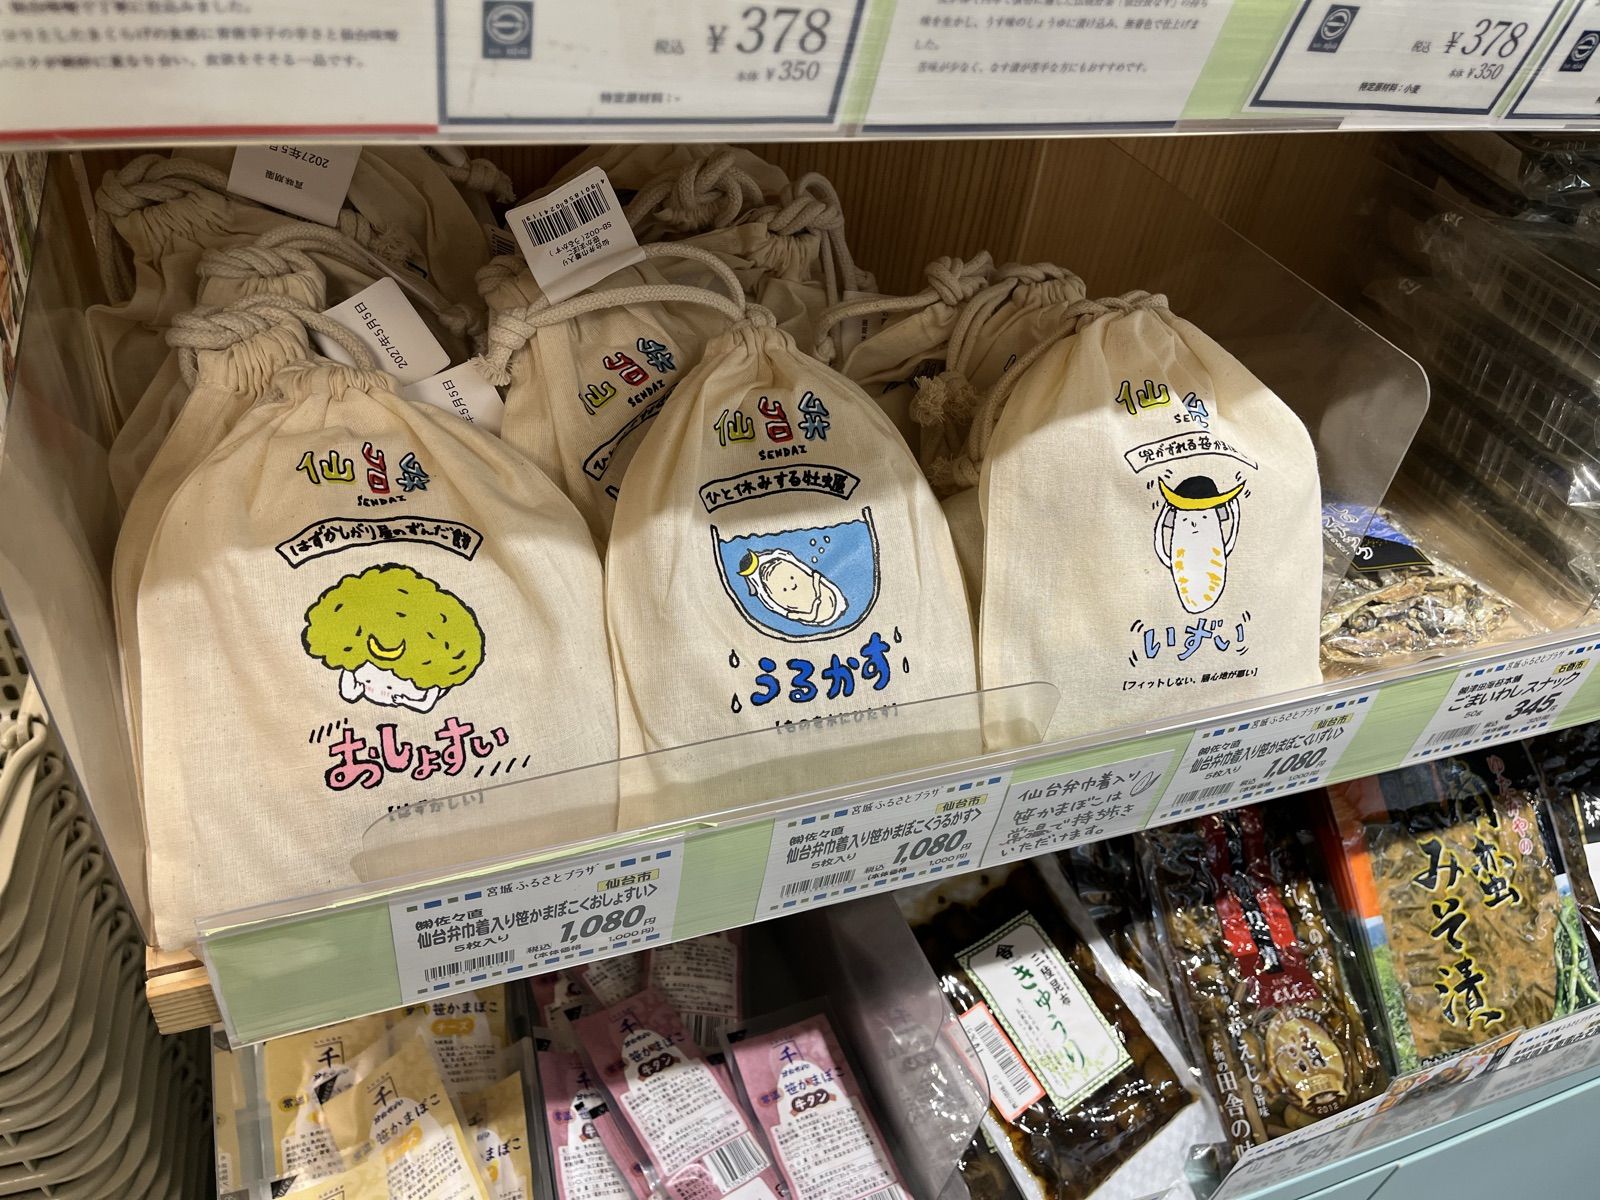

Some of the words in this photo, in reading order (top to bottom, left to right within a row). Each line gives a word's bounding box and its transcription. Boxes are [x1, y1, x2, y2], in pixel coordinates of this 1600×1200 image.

[354, 301, 409, 369] 2027年5月5日
[627, 379, 666, 408] SENDAI
[714, 391, 831, 446] 仙台弁
[758, 445, 807, 461] SENDAI
[296, 442, 431, 494] 仙台弁
[357, 494, 407, 507] SENDAI
[1144, 618, 1245, 661] いずい
[750, 632, 891, 706] うるかす
[1448, 671, 1581, 712] ごまいわしスナック
[1316, 716, 1347, 729] 仙台市
[324, 716, 510, 791] おしょすい
[1018, 770, 1141, 802] 仙台弁巾着入り
[942, 795, 981, 812] 仙台市
[1013, 791, 1123, 826] 笹かまぼこは
[1003, 804, 1135, 845] 常温で持ち歩き
[810, 852, 857, 869] 5枚入り
[863, 864, 885, 874] 税込
[605, 872, 651, 890] 仙台市
[453, 933, 509, 953] 5枚入り
[1411, 836, 1505, 1031] みそ漬
[526, 943, 553, 955] 税込
[433, 1001, 499, 1016] 笹かまぼこ
[1010, 965, 1085, 1069] きゅうり
[780, 1046, 797, 1064] 千
[784, 1067, 845, 1096] 笹かまぼこ
[794, 1092, 828, 1111] 牛タン
[1317, 1103, 1340, 1114] 2012
[376, 1093, 441, 1145] 笹かまぼこ
